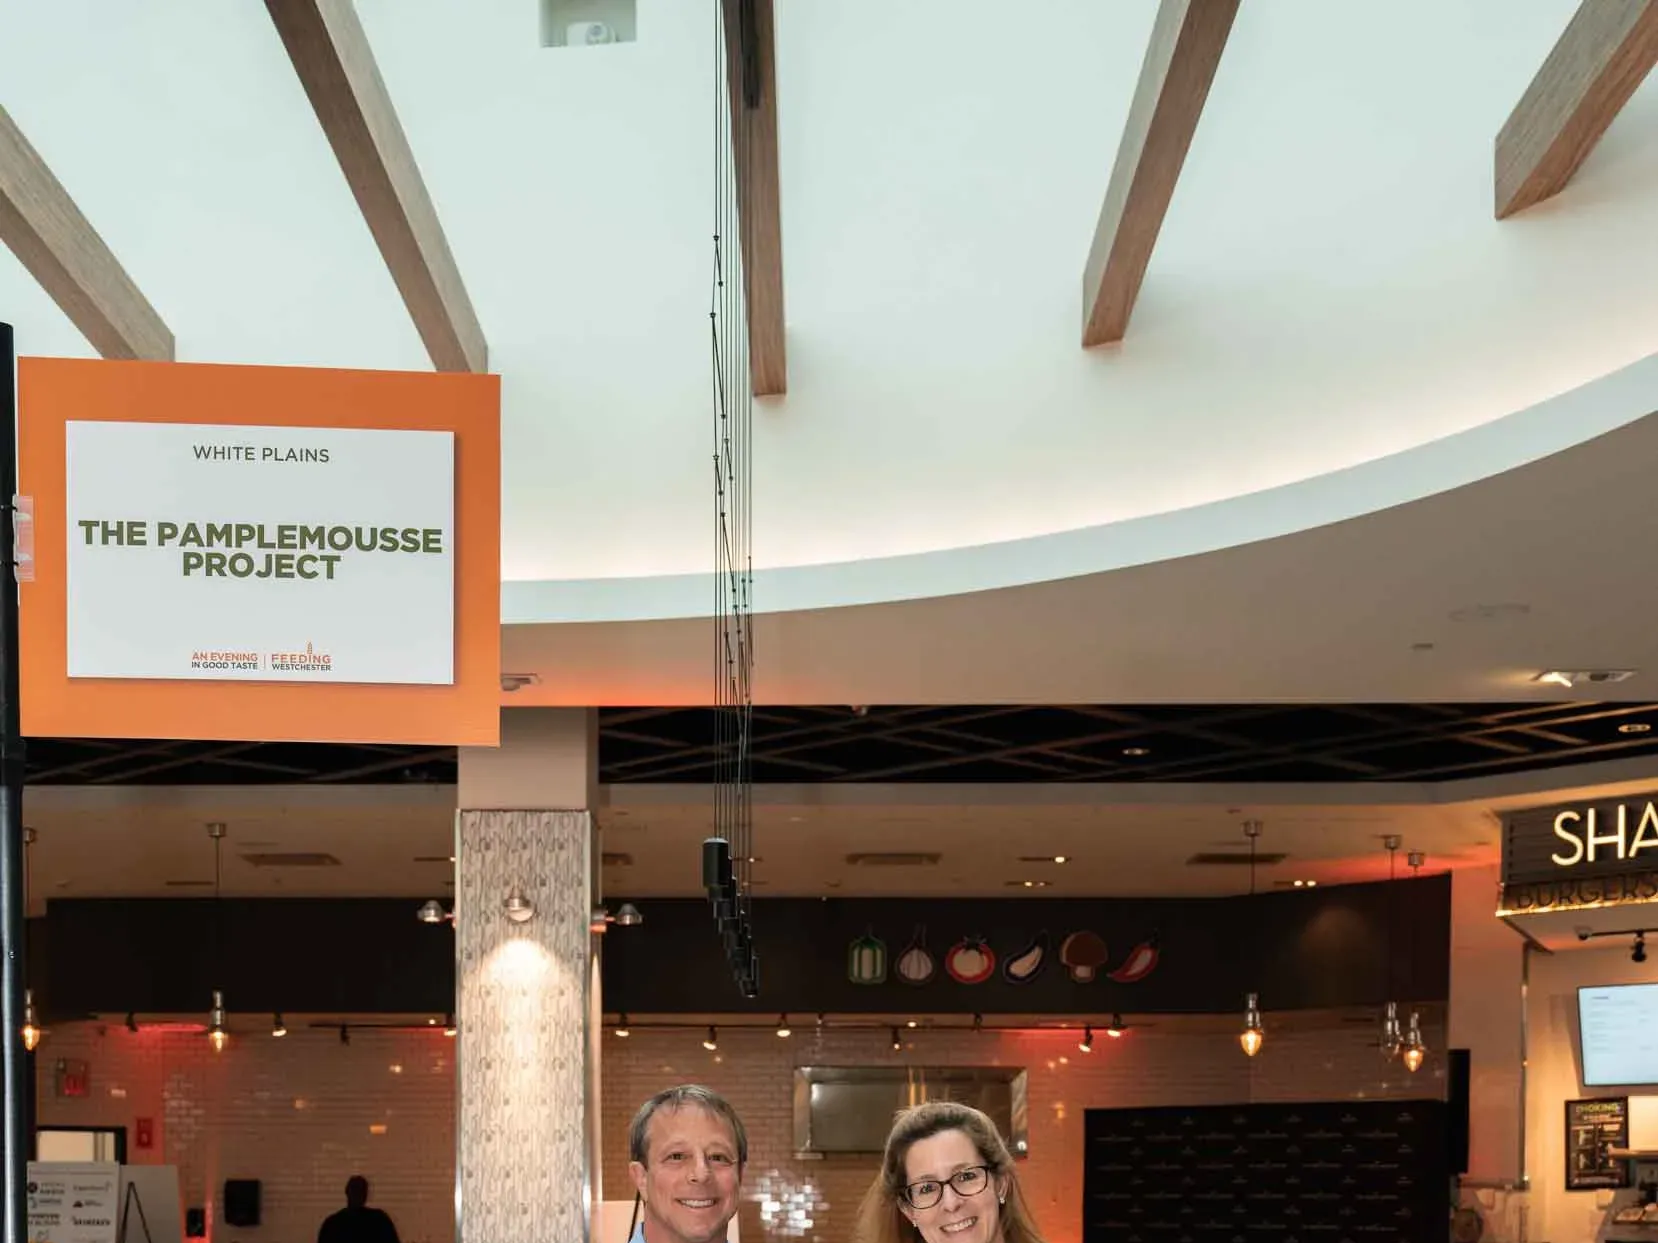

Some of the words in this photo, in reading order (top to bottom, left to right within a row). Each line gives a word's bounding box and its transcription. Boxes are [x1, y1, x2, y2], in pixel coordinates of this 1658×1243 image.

[193, 445, 256, 461] WHITE
[262, 447, 330, 463] PLAINS
[78, 519, 147, 546] THE
[157, 521, 443, 554] PAMPLEMOUSSE
[182, 551, 341, 580] PROJECT
[192, 651, 208, 661] AN
[210, 652, 258, 662] EVENING
[271, 654, 331, 664] FEEDING
[191, 661, 200, 669] IN
[202, 661, 229, 669] GOOD
[231, 662, 258, 670] TASTE
[272, 663, 331, 671] WESTCHESTER
